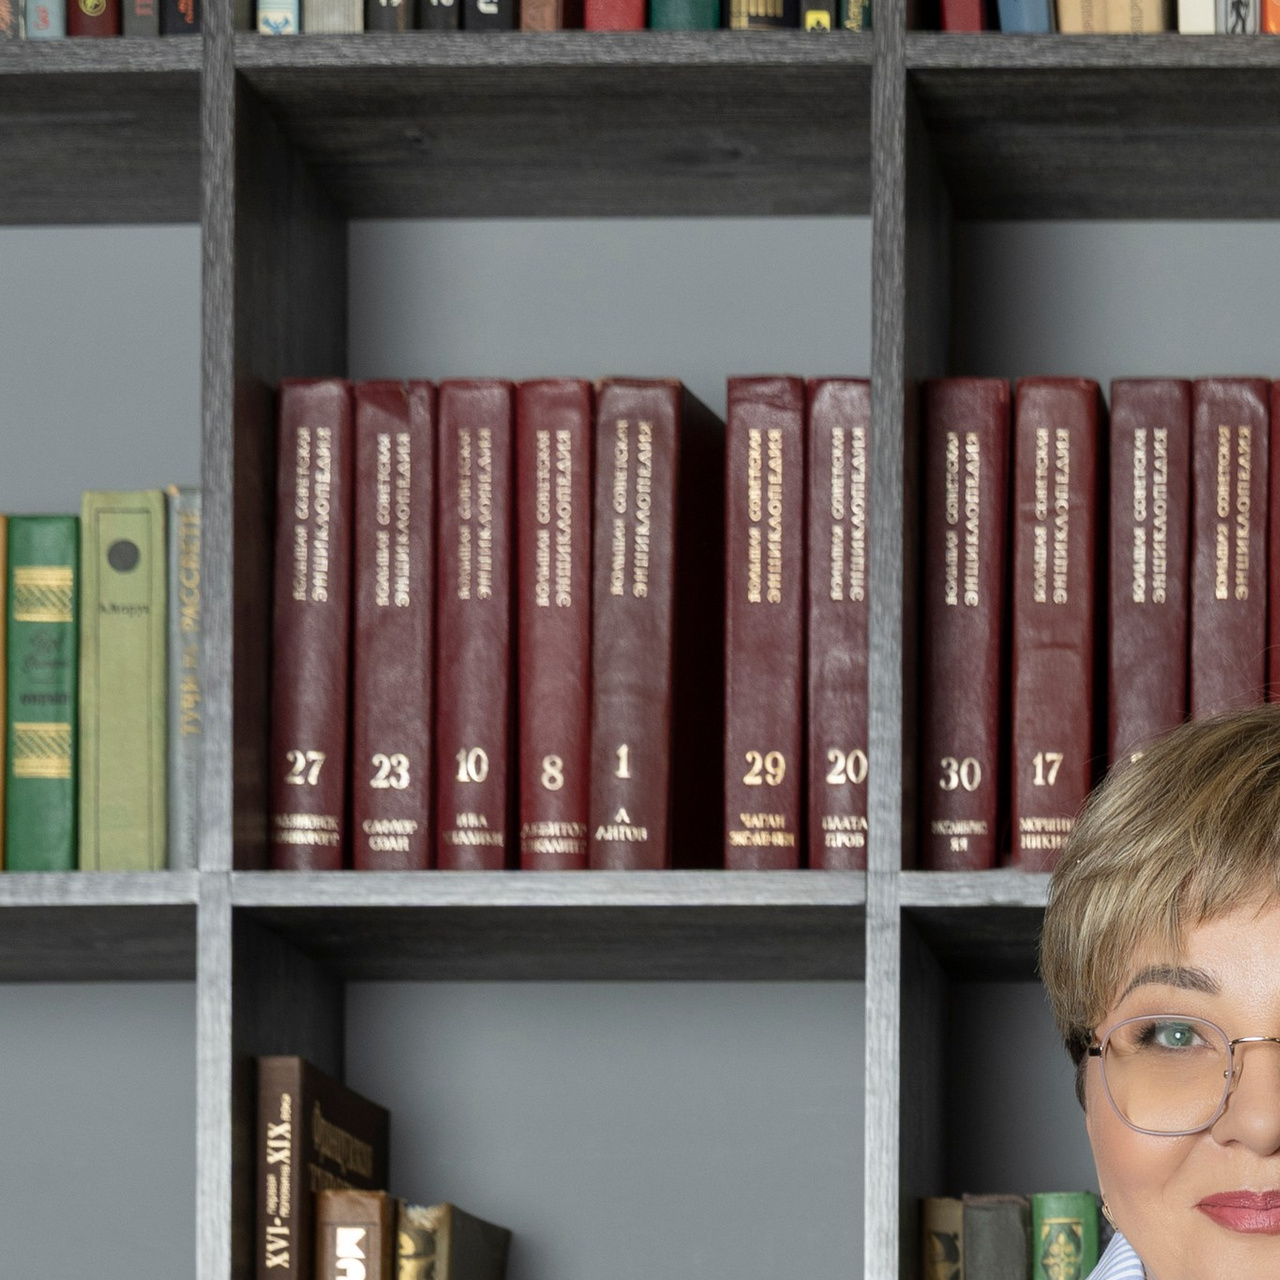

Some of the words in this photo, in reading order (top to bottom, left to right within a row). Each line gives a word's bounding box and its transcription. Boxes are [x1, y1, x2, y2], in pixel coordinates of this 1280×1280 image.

[179, 509, 201, 631] РАССВЕТЕ
[180, 675, 201, 736] ТУЧИ
[284, 750, 326, 785] 27
[370, 754, 410, 789] 23
[456, 747, 489, 782] 10
[541, 755, 564, 790] 8
[616, 745, 630, 779] 1
[743, 751, 786, 786] 29
[826, 749, 868, 785] 20
[940, 757, 981, 791] 30
[1033, 752, 1063, 786] 17
[267, 1122, 291, 1165] XIX
